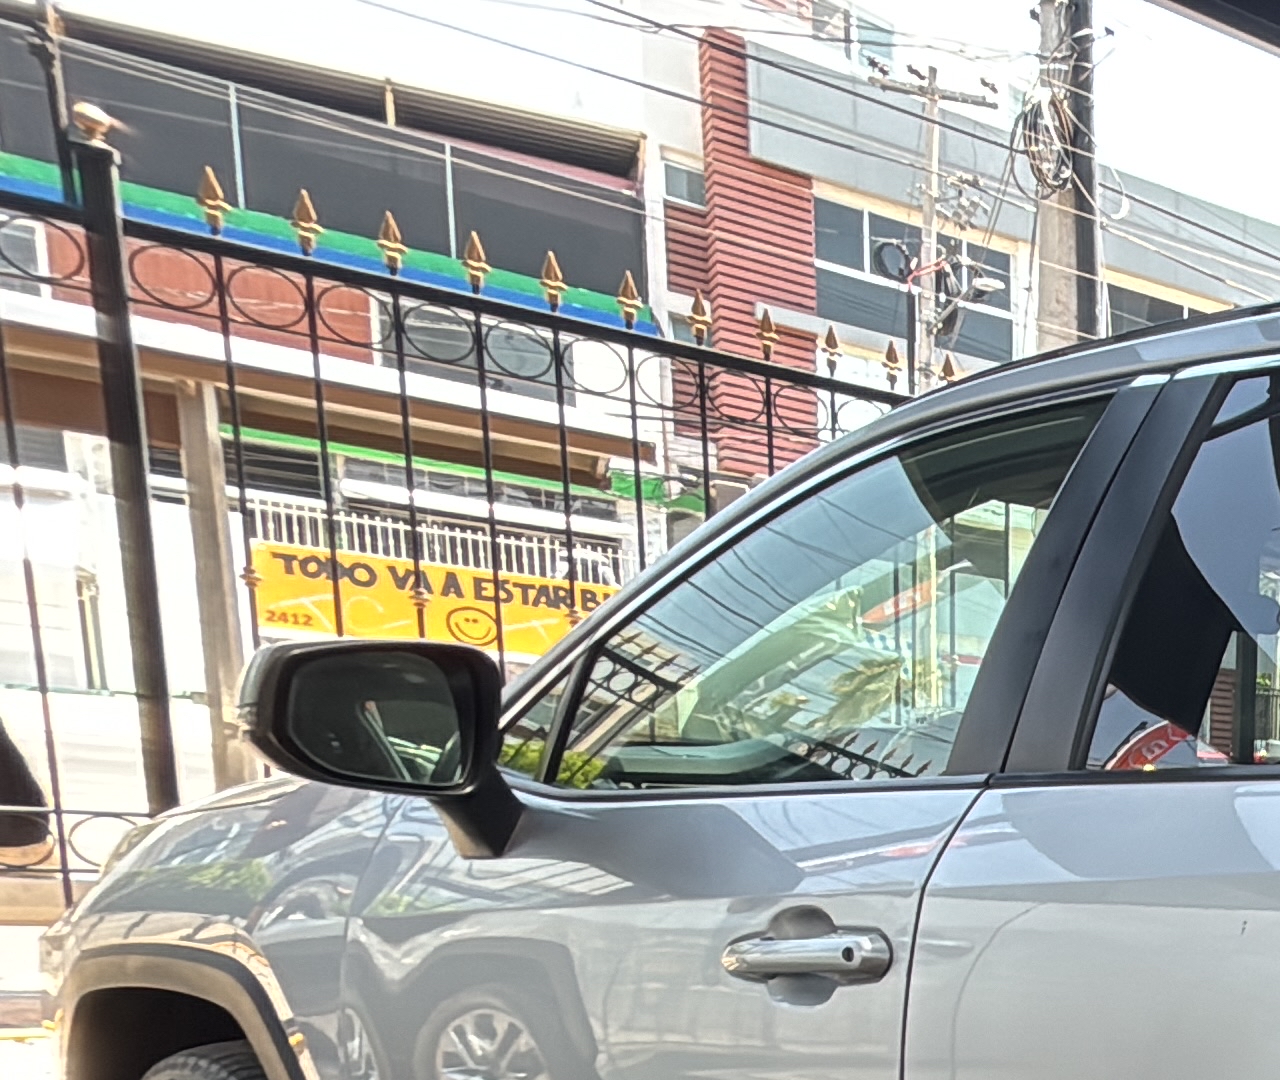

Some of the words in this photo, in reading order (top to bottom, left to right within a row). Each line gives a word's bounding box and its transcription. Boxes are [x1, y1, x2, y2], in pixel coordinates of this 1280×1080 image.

[271, 551, 377, 588] TODO
[386, 565, 434, 595] VA
[440, 571, 465, 598] A
[473, 576, 574, 610] ESTAR
[265, 610, 313, 627] 2412
